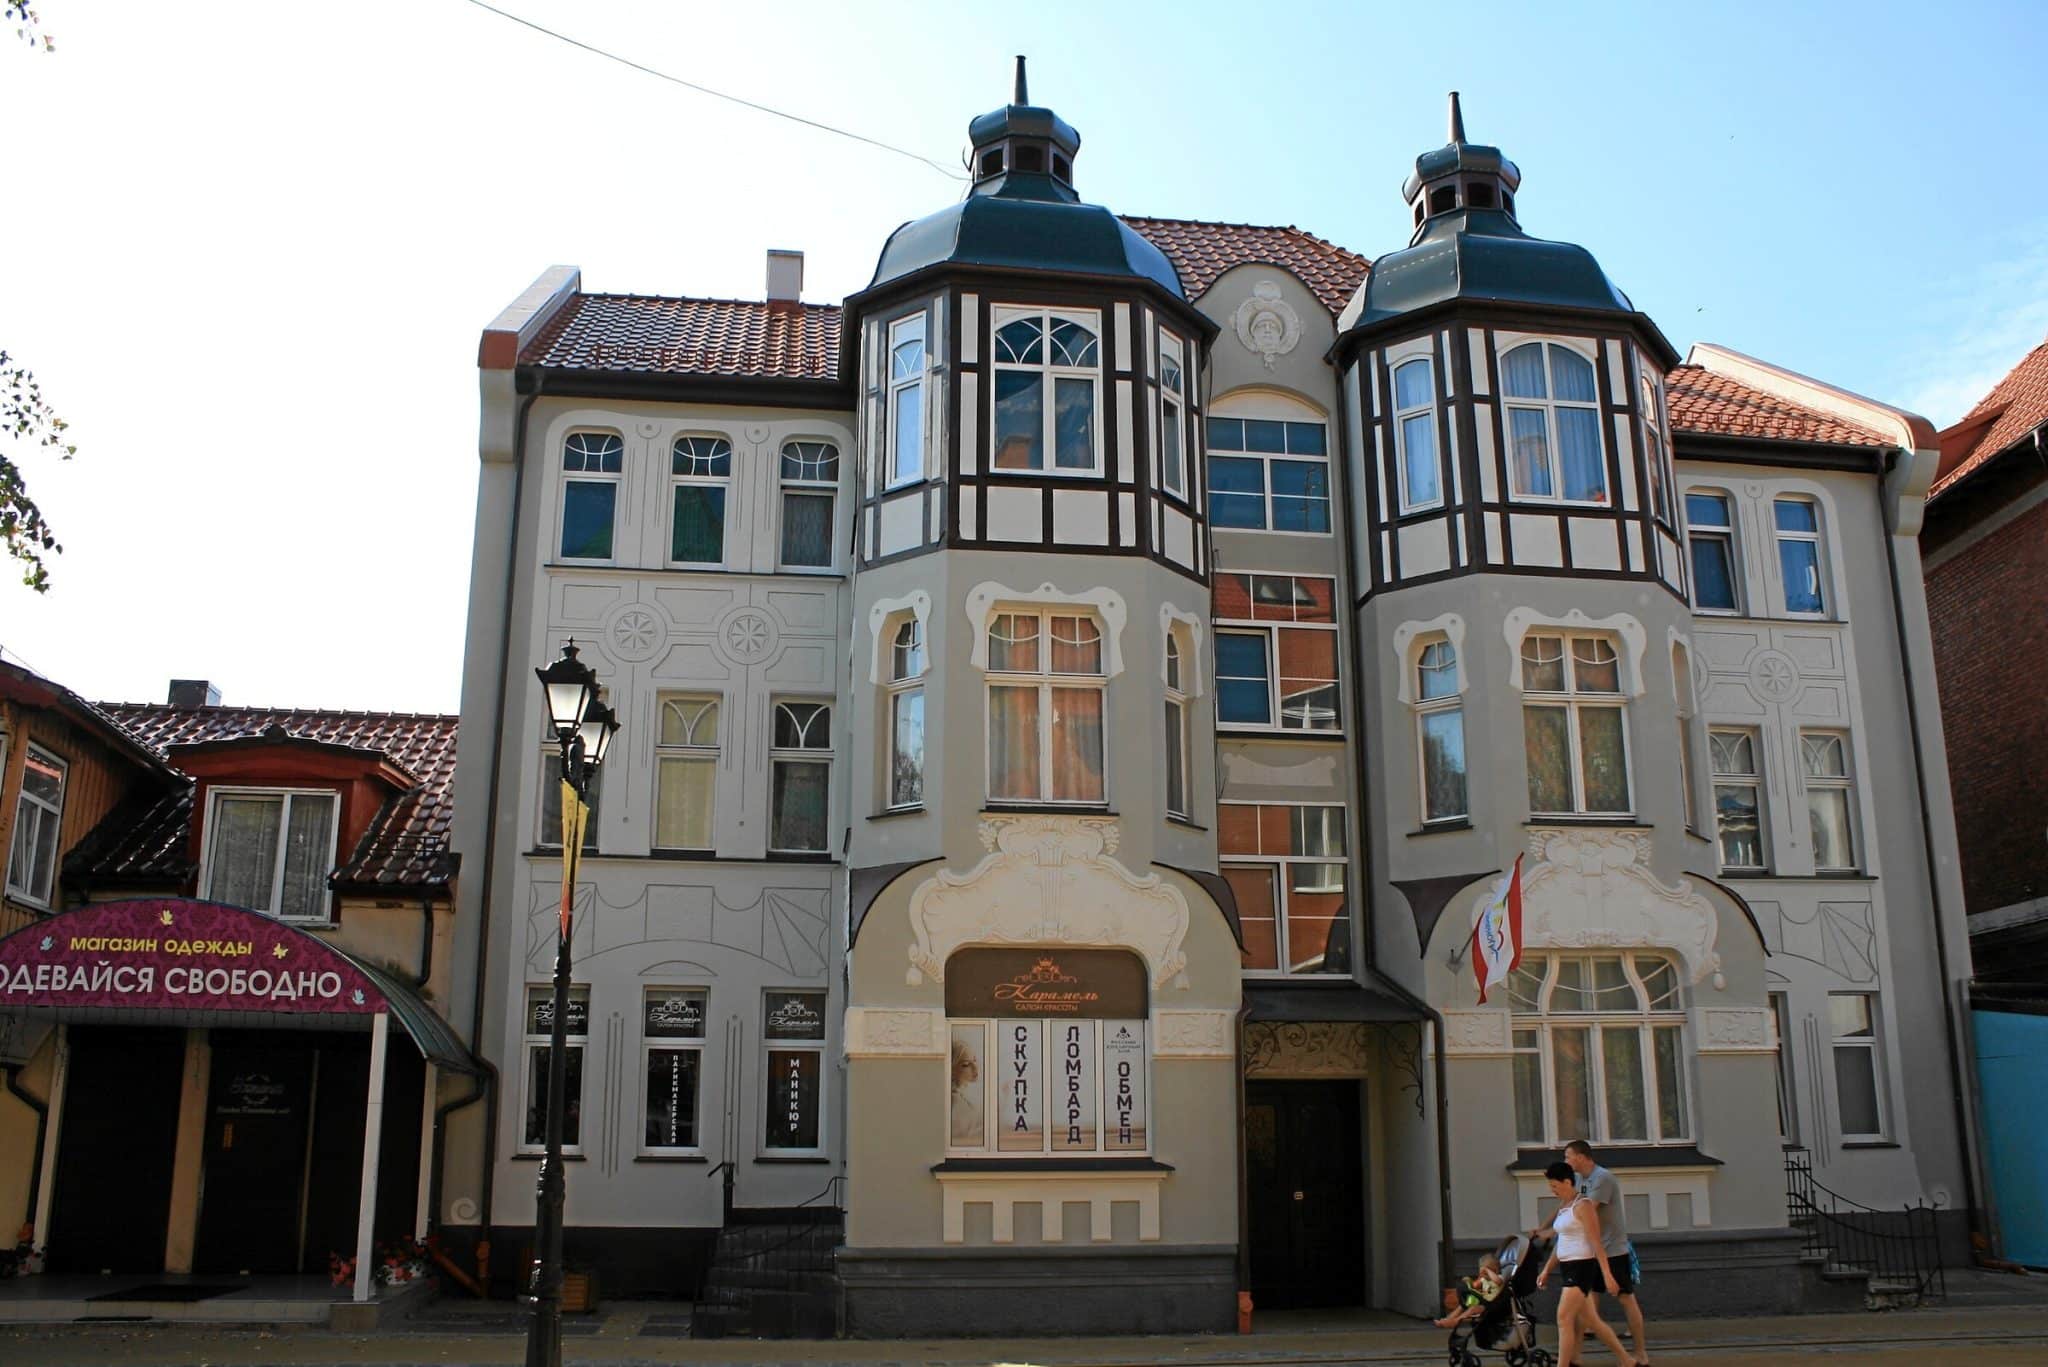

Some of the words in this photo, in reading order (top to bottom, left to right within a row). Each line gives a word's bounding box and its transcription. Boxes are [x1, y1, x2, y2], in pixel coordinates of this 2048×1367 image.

[70, 937, 157, 953] магазин
[164, 939, 253, 957] одежды
[165, 967, 342, 1000] СВОБОДНО
[994, 983, 1098, 1002] Карамель
[788, 1059, 800, 1132] МАНИКЮР
[1014, 1026, 1028, 1131] СКУПКА
[1066, 1026, 1082, 1144] ЛОМБАРД
[1117, 1062, 1133, 1144] ОБМЕН
